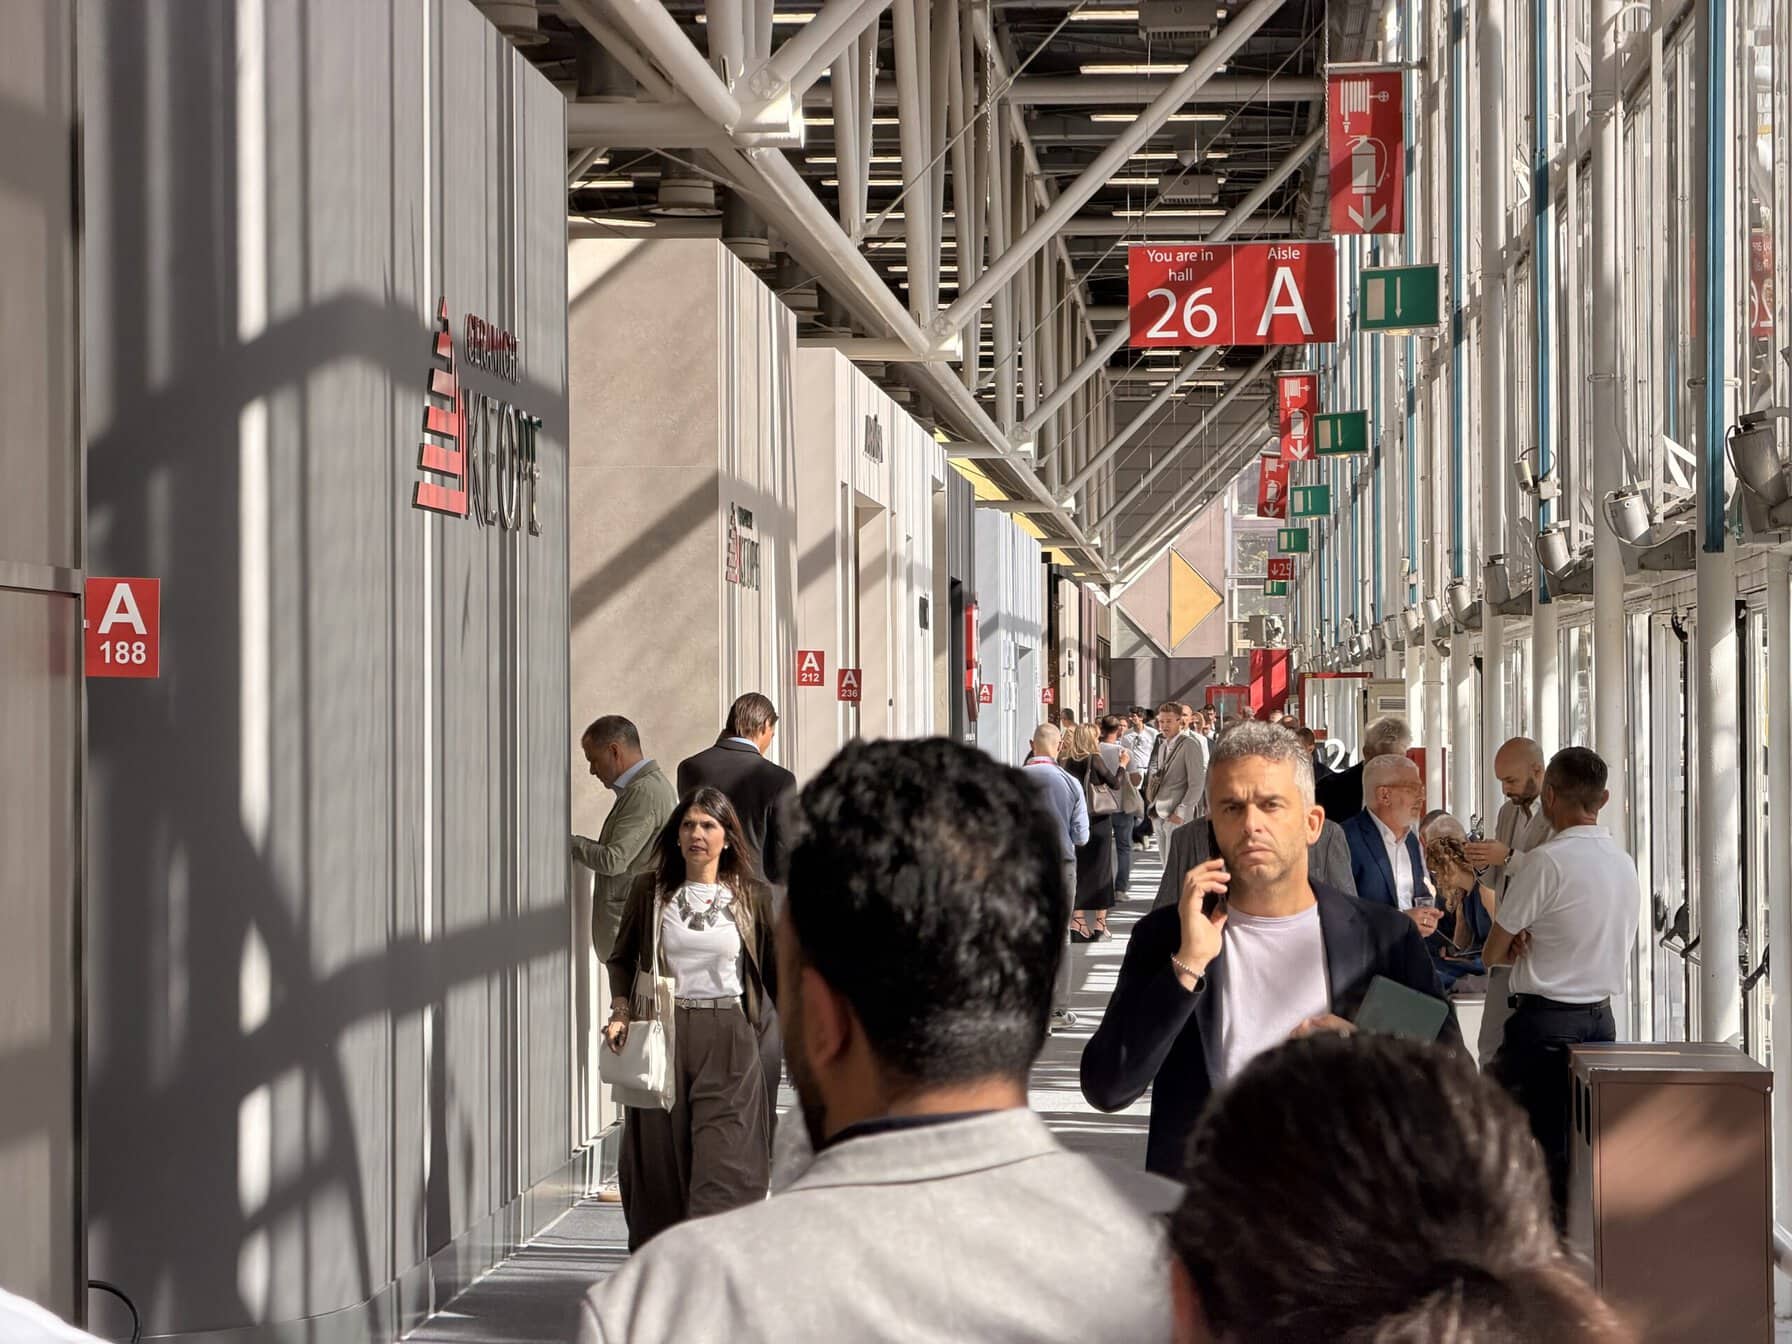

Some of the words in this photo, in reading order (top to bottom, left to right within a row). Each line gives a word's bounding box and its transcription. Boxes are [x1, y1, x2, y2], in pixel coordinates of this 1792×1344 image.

[1147, 249, 1172, 262] You
[1176, 251, 1198, 262] are
[1201, 249, 1214, 262] in
[1268, 246, 1300, 260] Aisle
[1168, 268, 1193, 281] hall
[1256, 266, 1314, 336] A
[1147, 287, 1218, 338] 26
[465, 388, 543, 537] KEOPE
[97, 582, 148, 635] A
[100, 640, 146, 665] 188
[801, 652, 820, 672] A
[801, 673, 820, 682] 212
[841, 671, 858, 688] A
[980, 685, 991, 696] A
[1043, 689, 1051, 698] A
